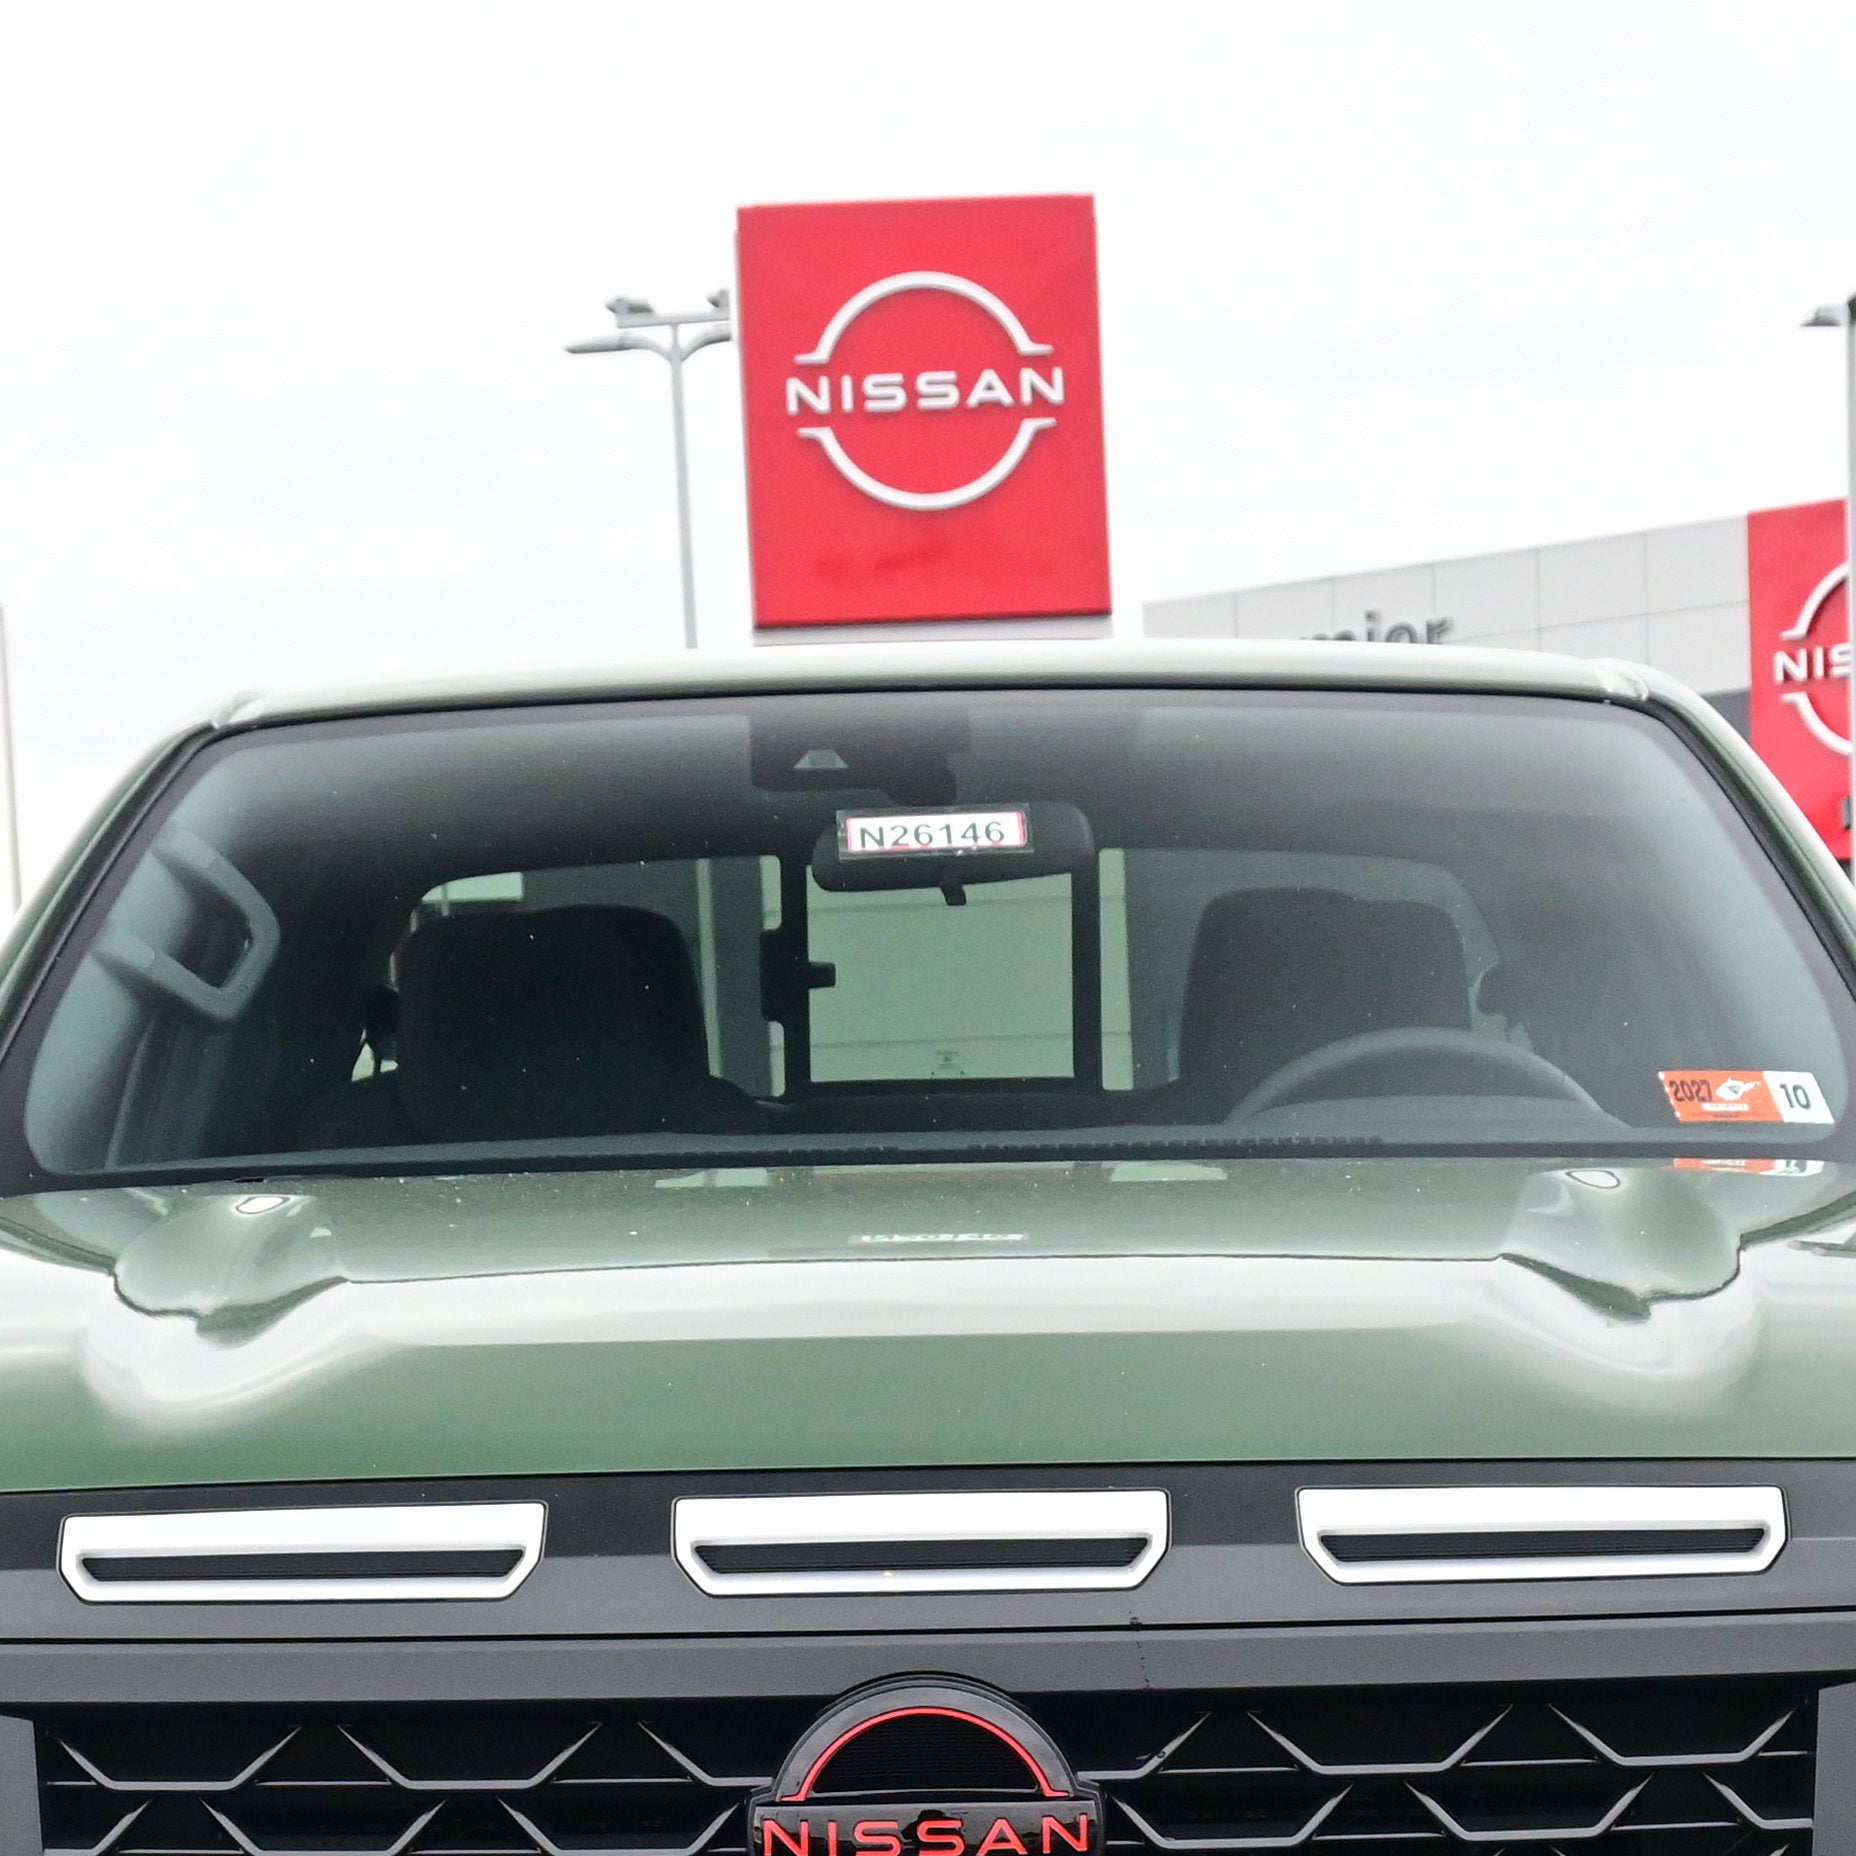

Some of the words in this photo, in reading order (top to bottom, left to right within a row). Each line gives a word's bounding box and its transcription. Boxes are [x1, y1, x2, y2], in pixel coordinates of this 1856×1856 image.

[785, 366, 1066, 416] NISSAN
[859, 820, 1006, 849] N26146
[1669, 1079, 1712, 1102] 2027
[1780, 1083, 1811, 1110] 10
